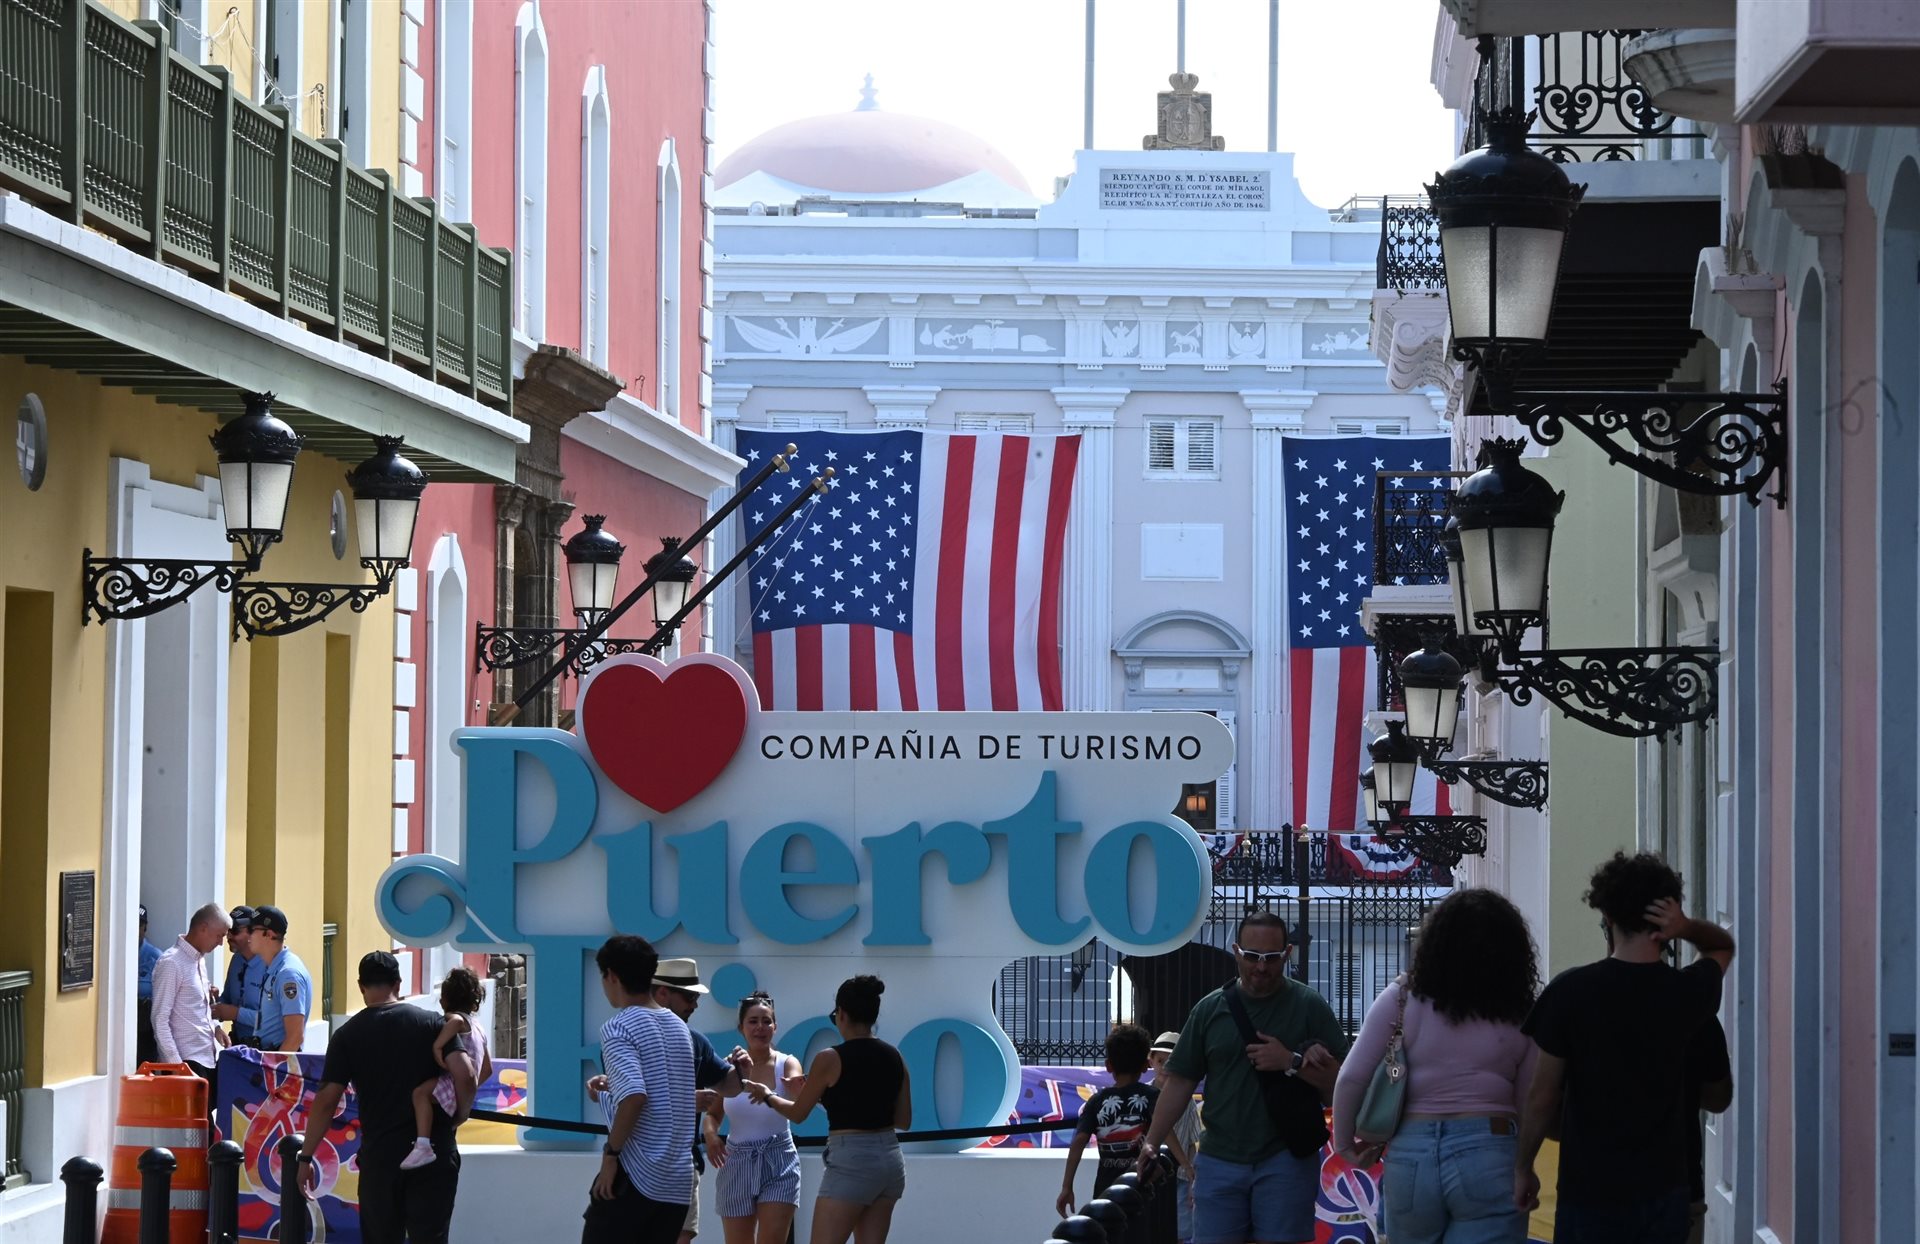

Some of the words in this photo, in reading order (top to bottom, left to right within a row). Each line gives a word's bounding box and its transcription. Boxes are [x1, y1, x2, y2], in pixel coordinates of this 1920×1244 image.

[1112, 173, 1171, 182] REYNANDO
[1175, 174, 1184, 182] S.
[1186, 174, 1196, 182] M.
[1209, 174, 1249, 183] YSABEL
[760, 729, 962, 760] COMPAÑIA
[978, 735, 1021, 760] DE
[1037, 735, 1202, 761] TURISMO
[379, 736, 1204, 947] Puerto
